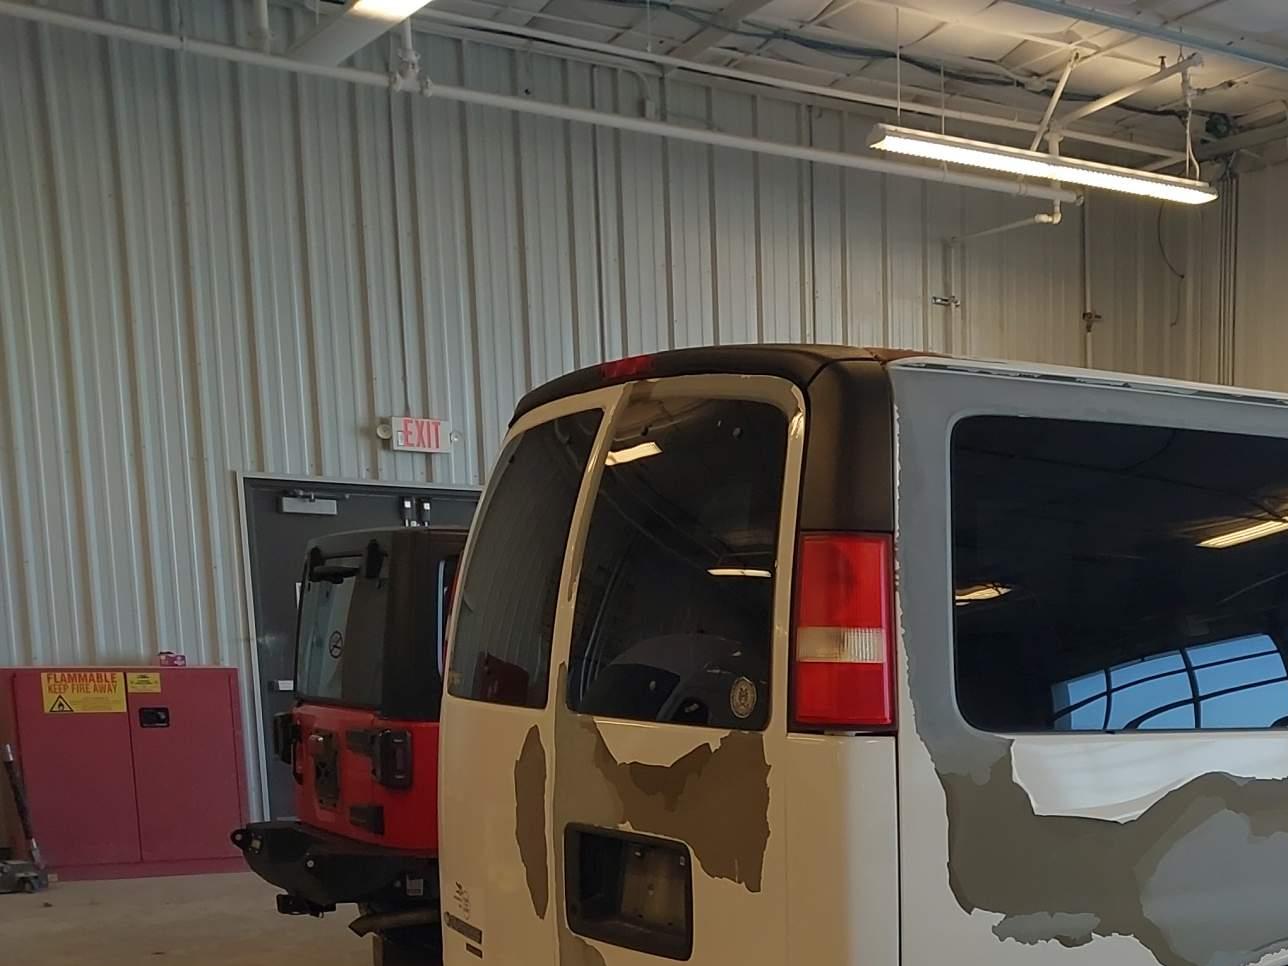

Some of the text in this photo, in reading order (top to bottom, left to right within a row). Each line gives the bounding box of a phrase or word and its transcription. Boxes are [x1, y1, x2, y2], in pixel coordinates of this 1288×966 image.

[403, 418, 441, 449] EXIT
[46, 672, 118, 684] FLAMMABLE
[47, 684, 118, 694] KEEP FIRE AWAY
